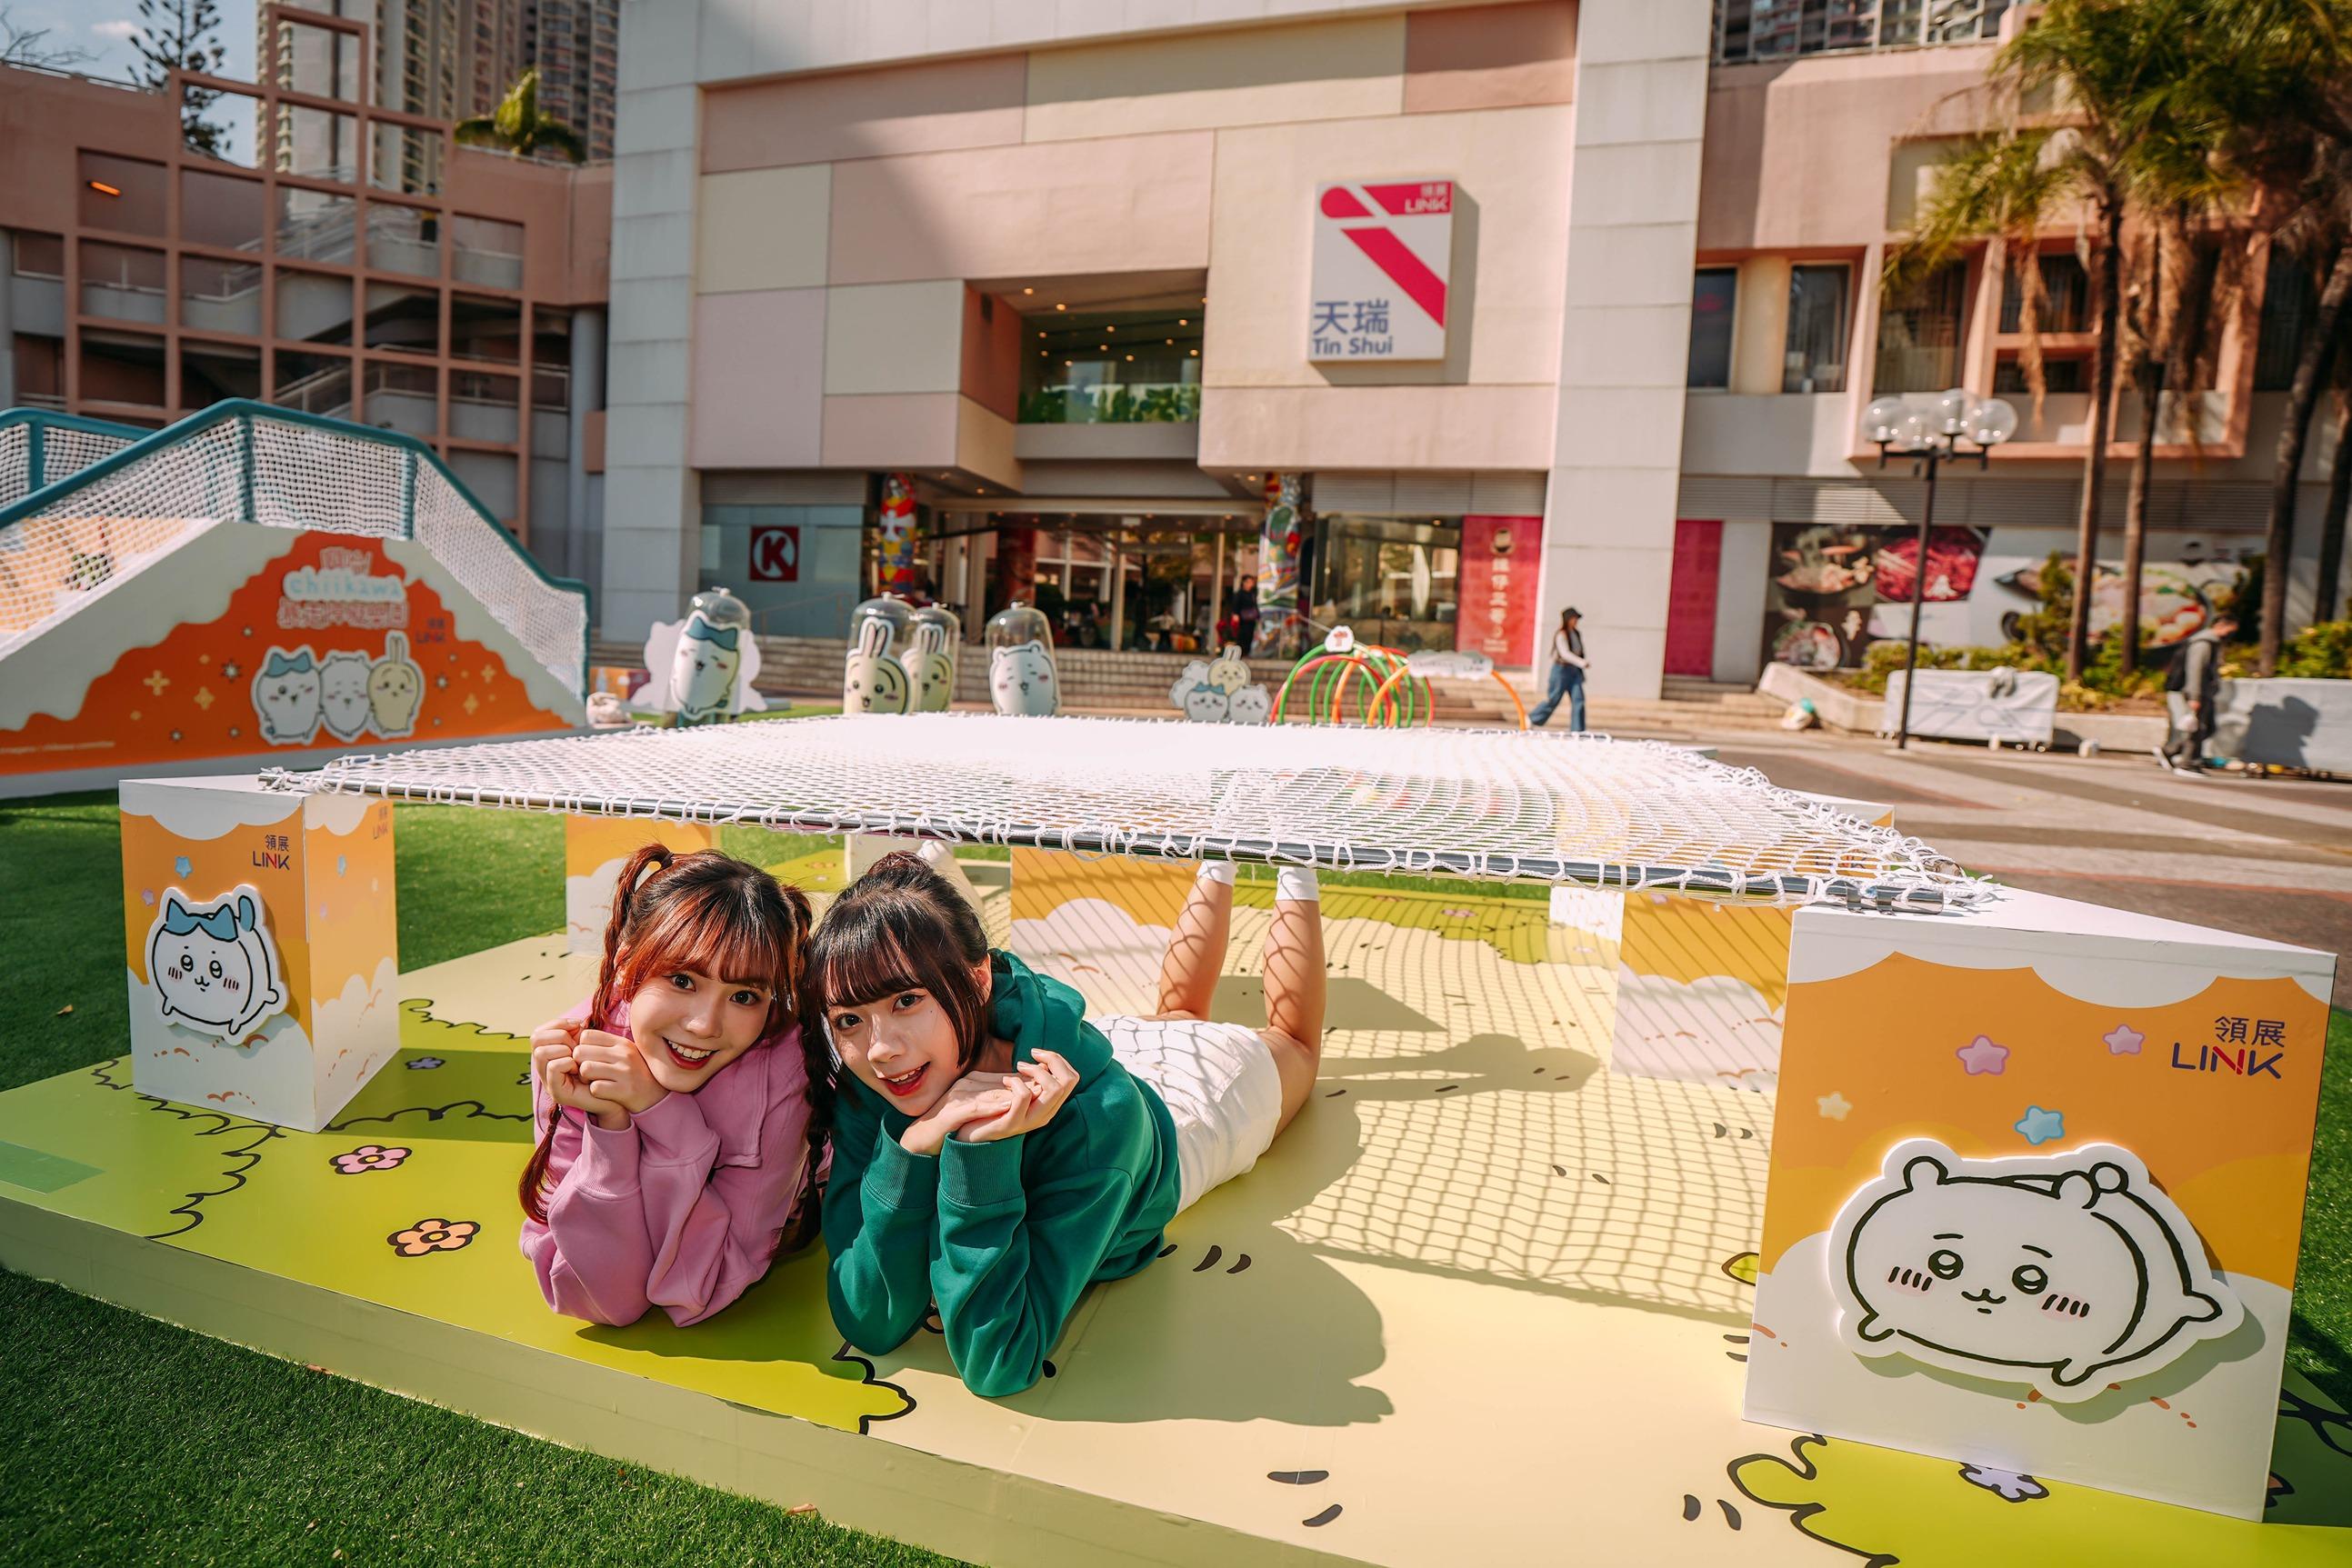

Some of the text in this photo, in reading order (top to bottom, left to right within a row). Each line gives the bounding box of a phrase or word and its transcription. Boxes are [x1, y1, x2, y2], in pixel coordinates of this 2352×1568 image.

[1405, 196, 1448, 213] LINK
[1313, 298, 1389, 335] 天瑞
[1313, 335, 1393, 355] Tin Shui
[762, 534, 793, 574] K
[265, 834, 289, 852] 領展
[253, 851, 290, 870] LINK
[2215, 1015, 2287, 1047] 領展
[2171, 1042, 2284, 1079] LINK
